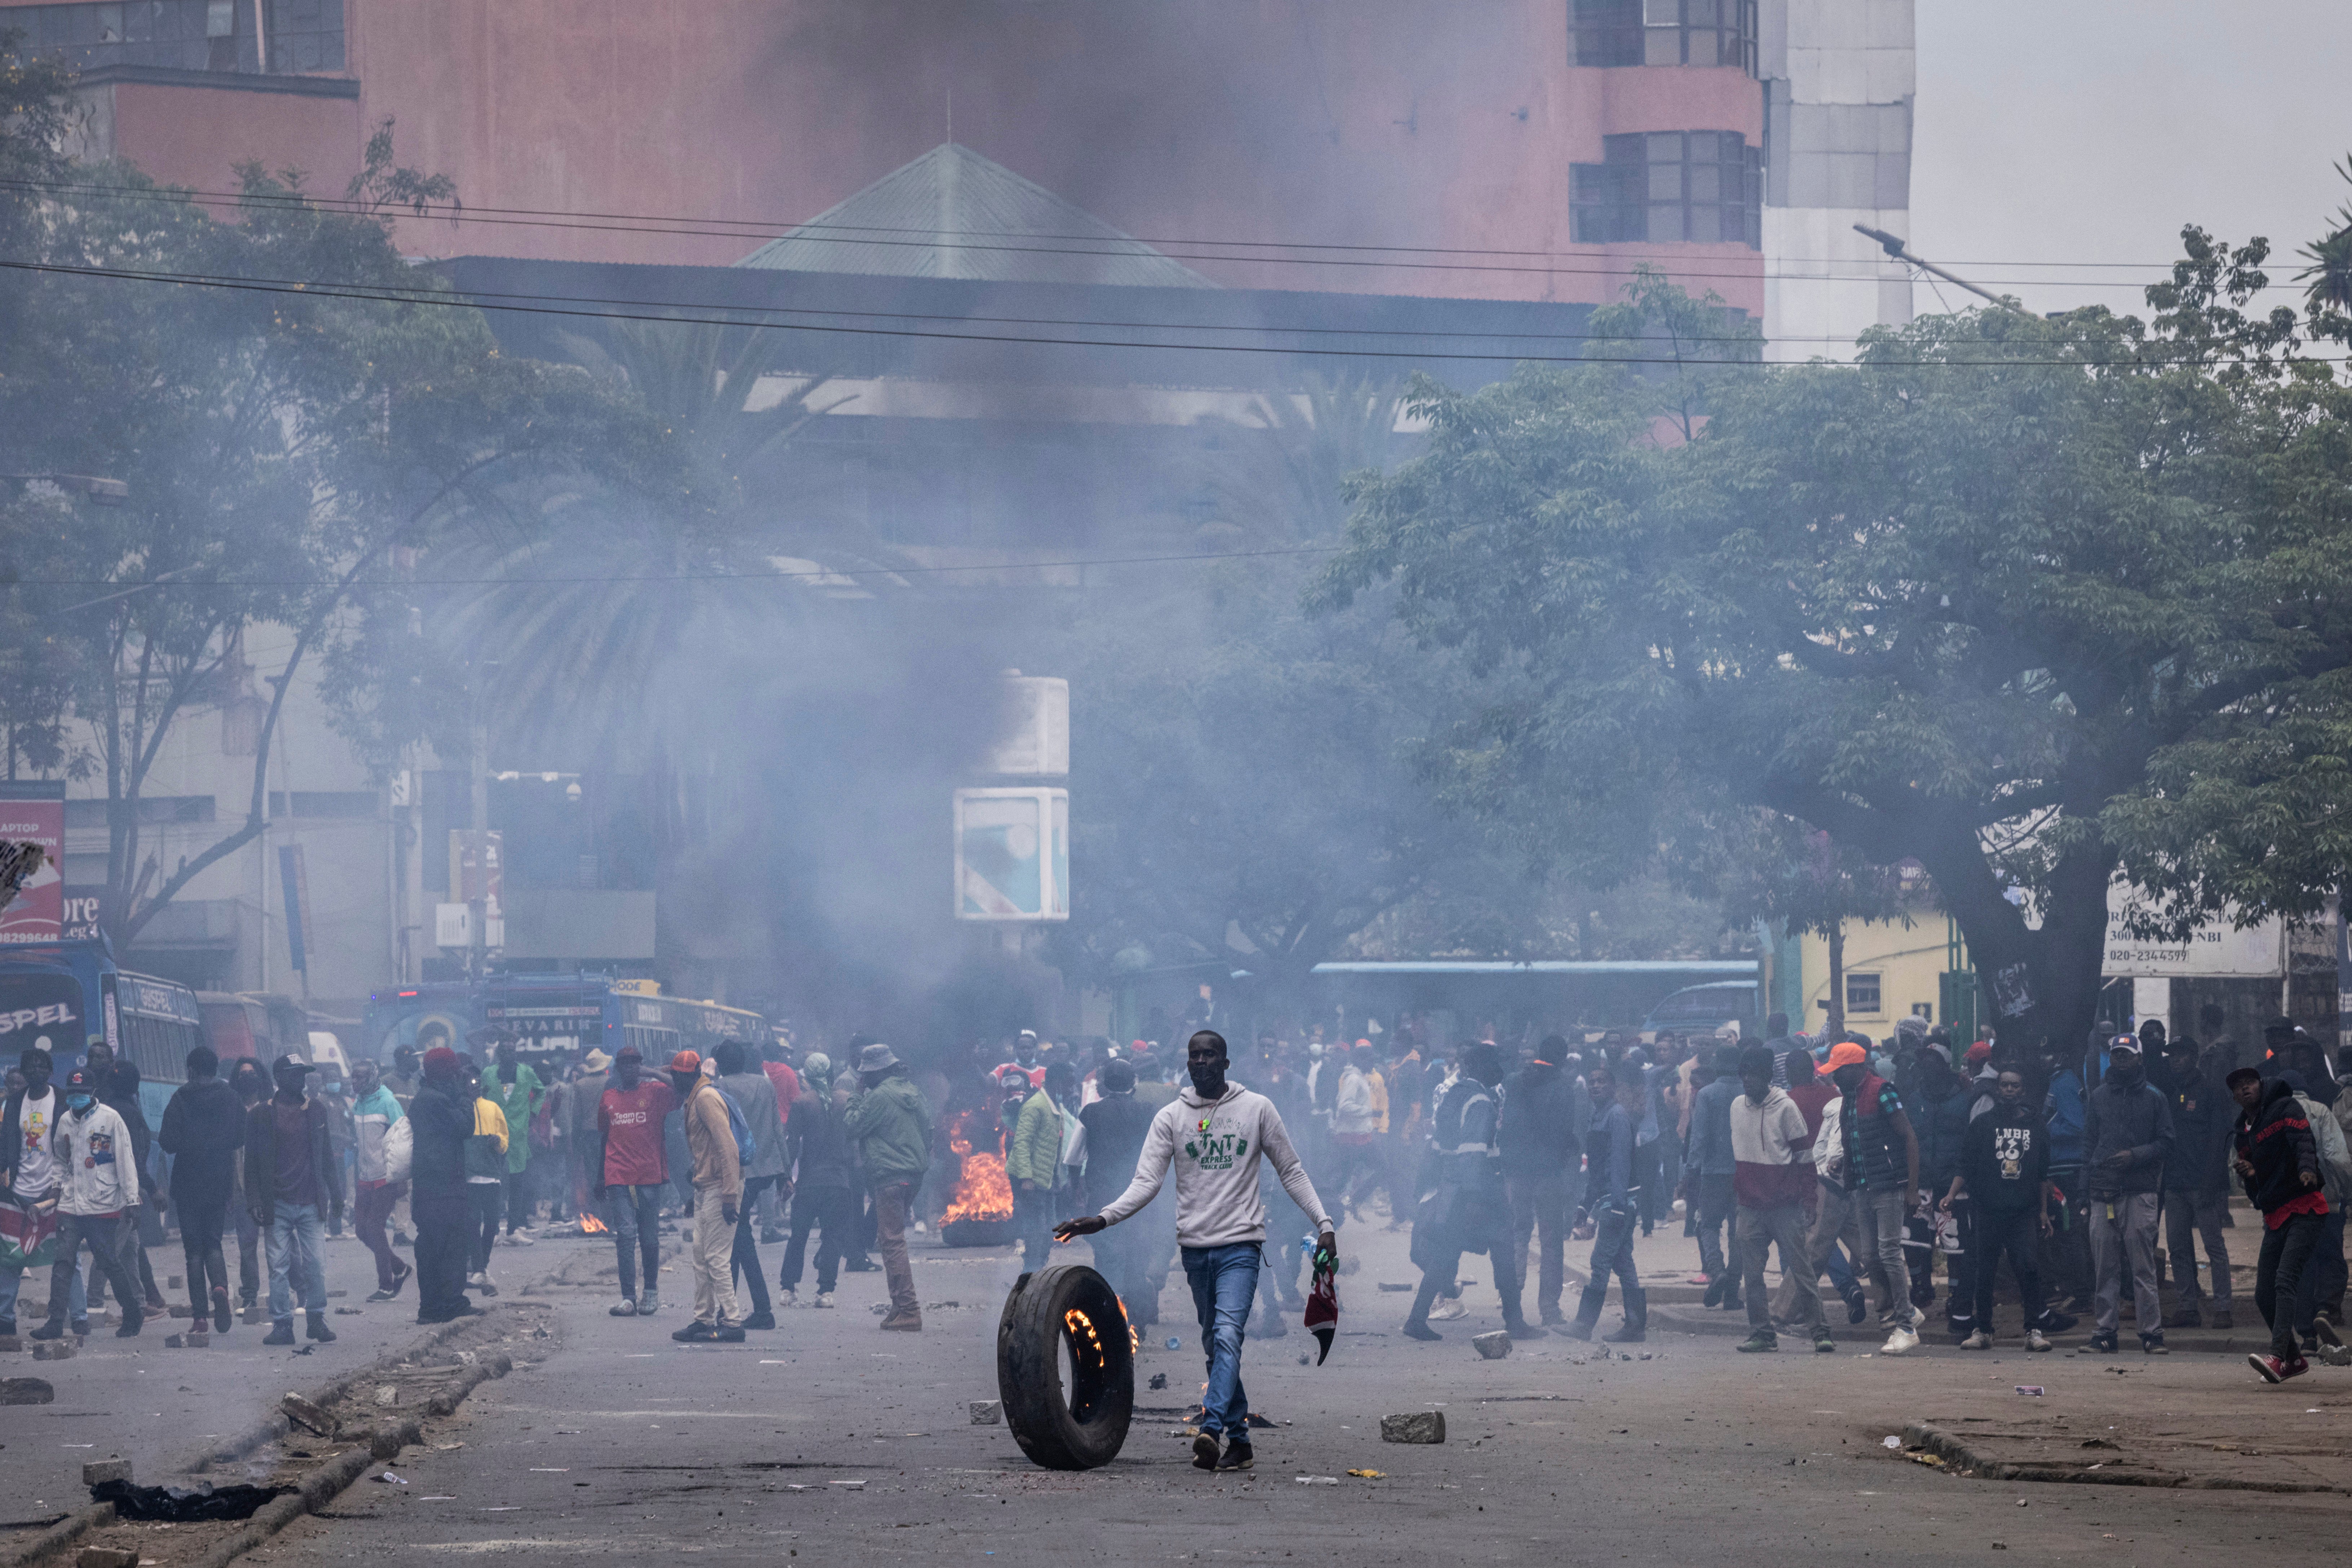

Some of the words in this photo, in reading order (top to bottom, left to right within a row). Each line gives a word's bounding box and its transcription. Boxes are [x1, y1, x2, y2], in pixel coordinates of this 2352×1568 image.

[0, 823, 39, 832] APTOP
[2197, 932, 2221, 942] NBI
[2110, 950, 2187, 961] 020-2344599
[1200, 1133, 1236, 1156] TNT
[1201, 1155, 1232, 1164] EXPRESS
